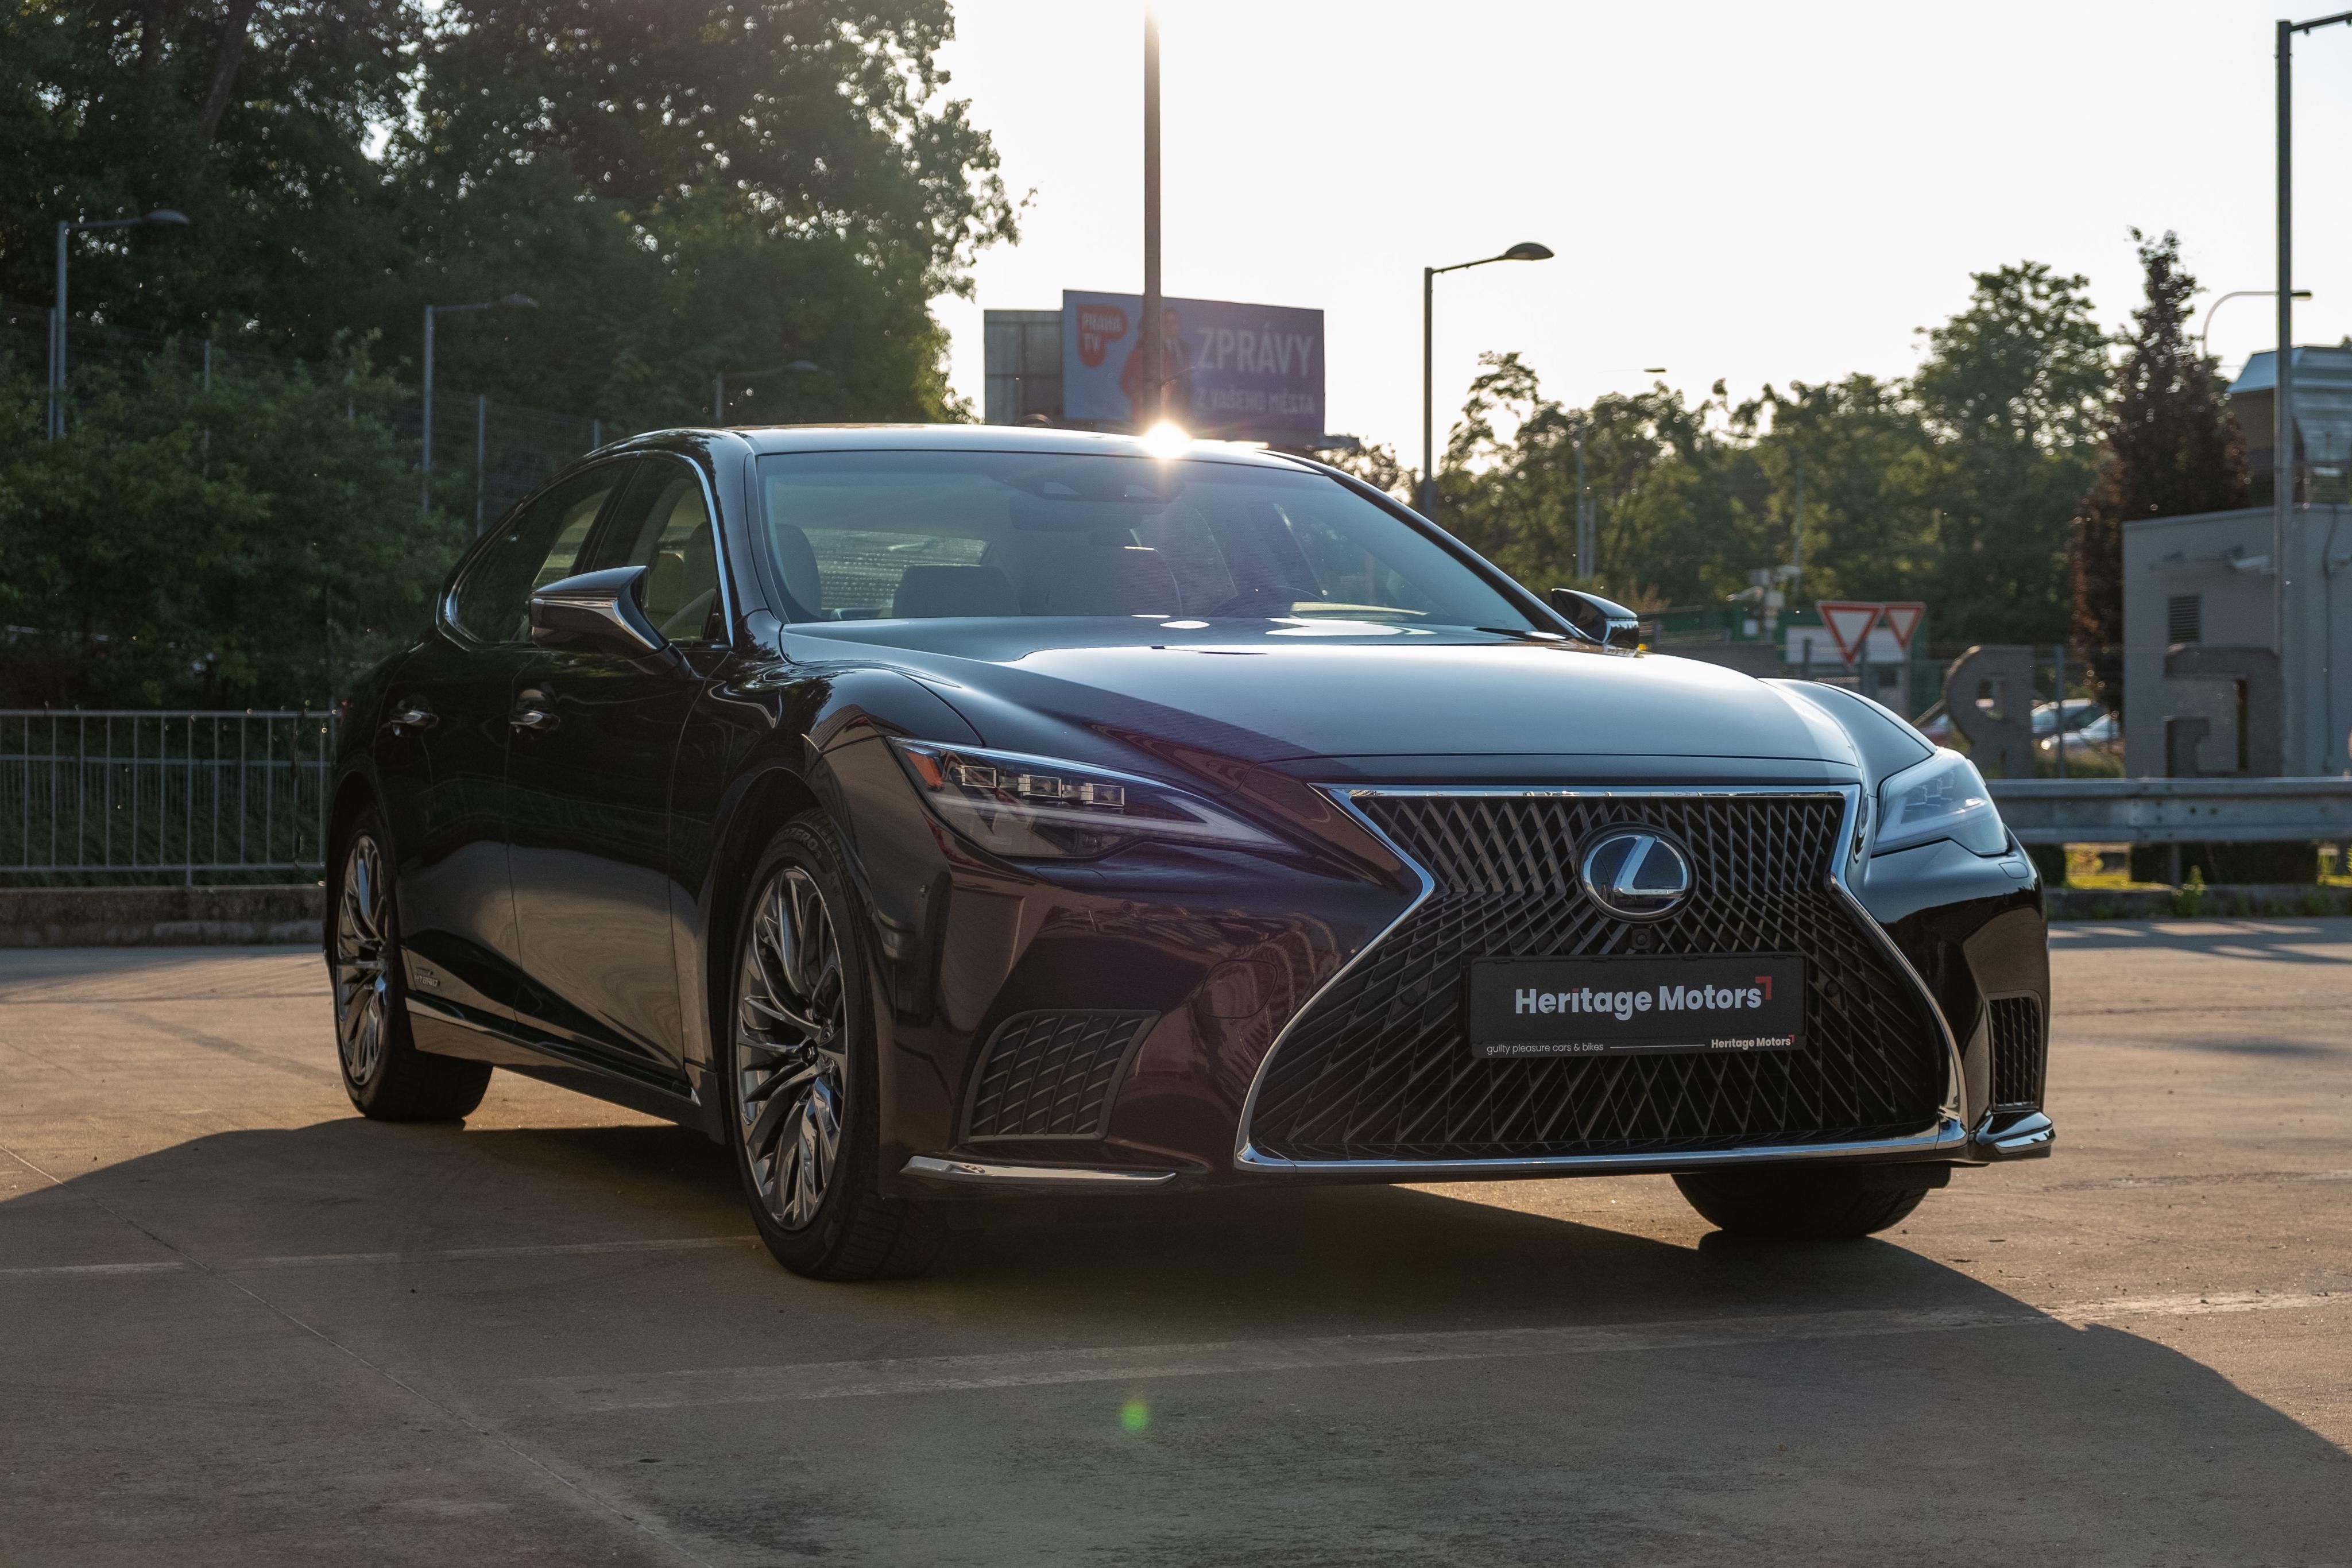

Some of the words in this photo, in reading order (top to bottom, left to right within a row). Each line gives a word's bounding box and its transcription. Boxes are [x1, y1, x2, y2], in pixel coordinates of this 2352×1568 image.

[1084, 333, 1101, 351] TV
[1196, 322, 1314, 375] ZPRÁVY
[414, 974, 438, 987] HYBRID
[1515, 988, 1653, 1021] Heritage
[1659, 985, 1762, 1011] Motors
[1487, 1044, 1510, 1055] guilty
[1512, 1044, 1550, 1055] pleasure
[1552, 1043, 1572, 1051] cars
[1573, 1043, 1580, 1051] &
[1582, 1042, 1604, 1051] bikes
[1711, 1038, 1755, 1050] Heritage
[1756, 1037, 1791, 1047] Motors
